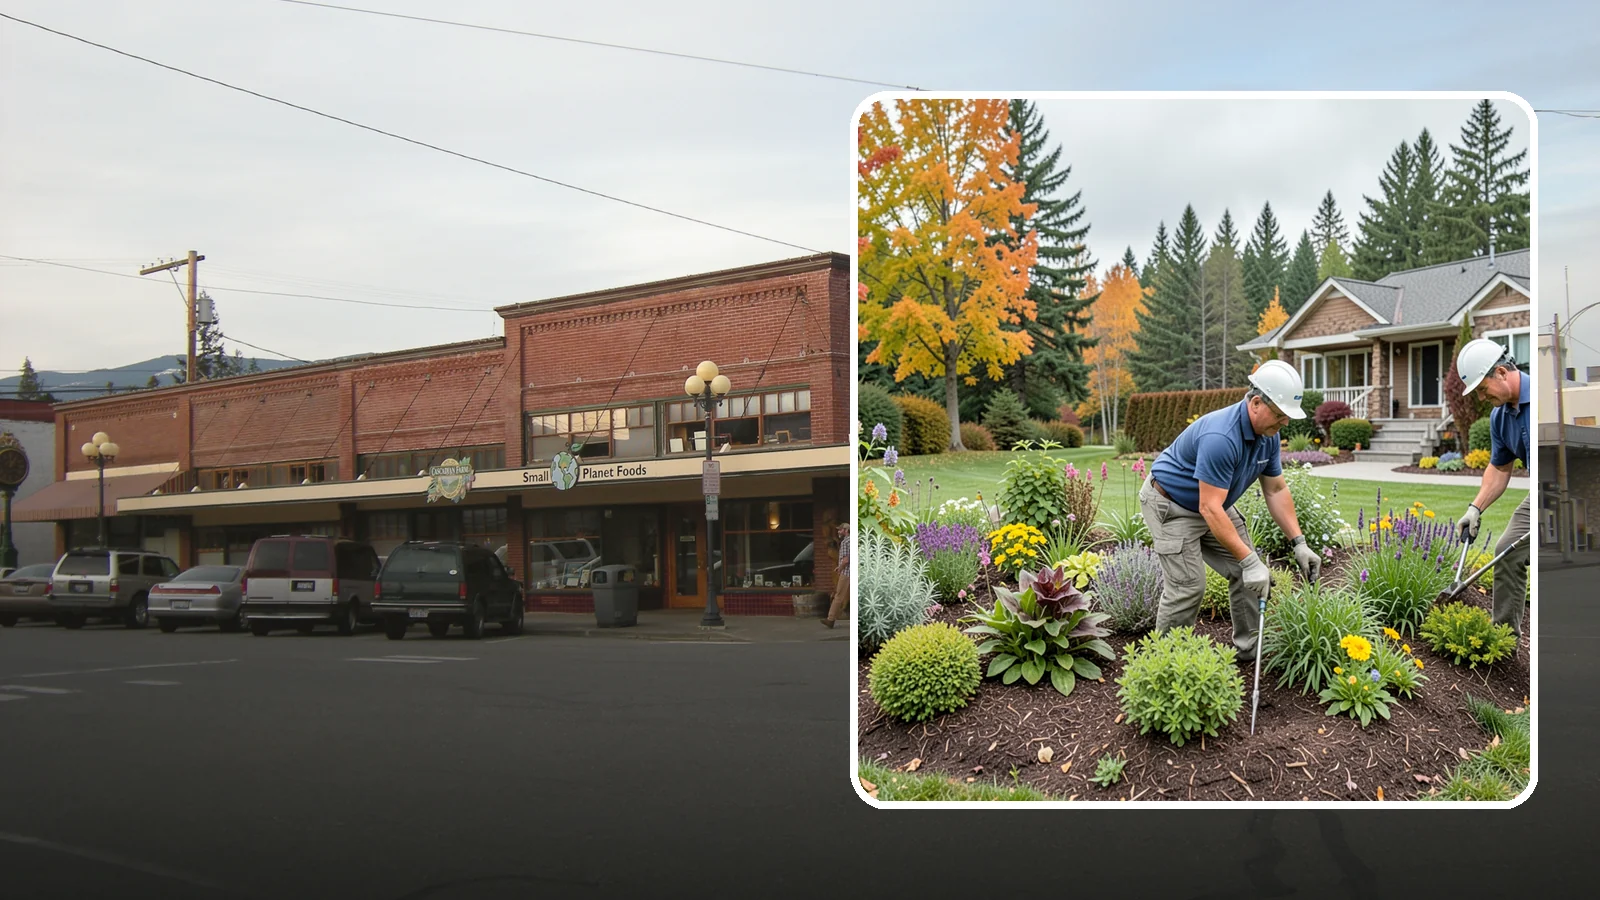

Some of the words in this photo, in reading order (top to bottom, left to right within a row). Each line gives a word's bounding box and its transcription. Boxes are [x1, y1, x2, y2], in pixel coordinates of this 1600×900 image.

[523, 471, 549, 483] Small
[583, 468, 614, 479] Planet
[617, 464, 647, 477] Foods
